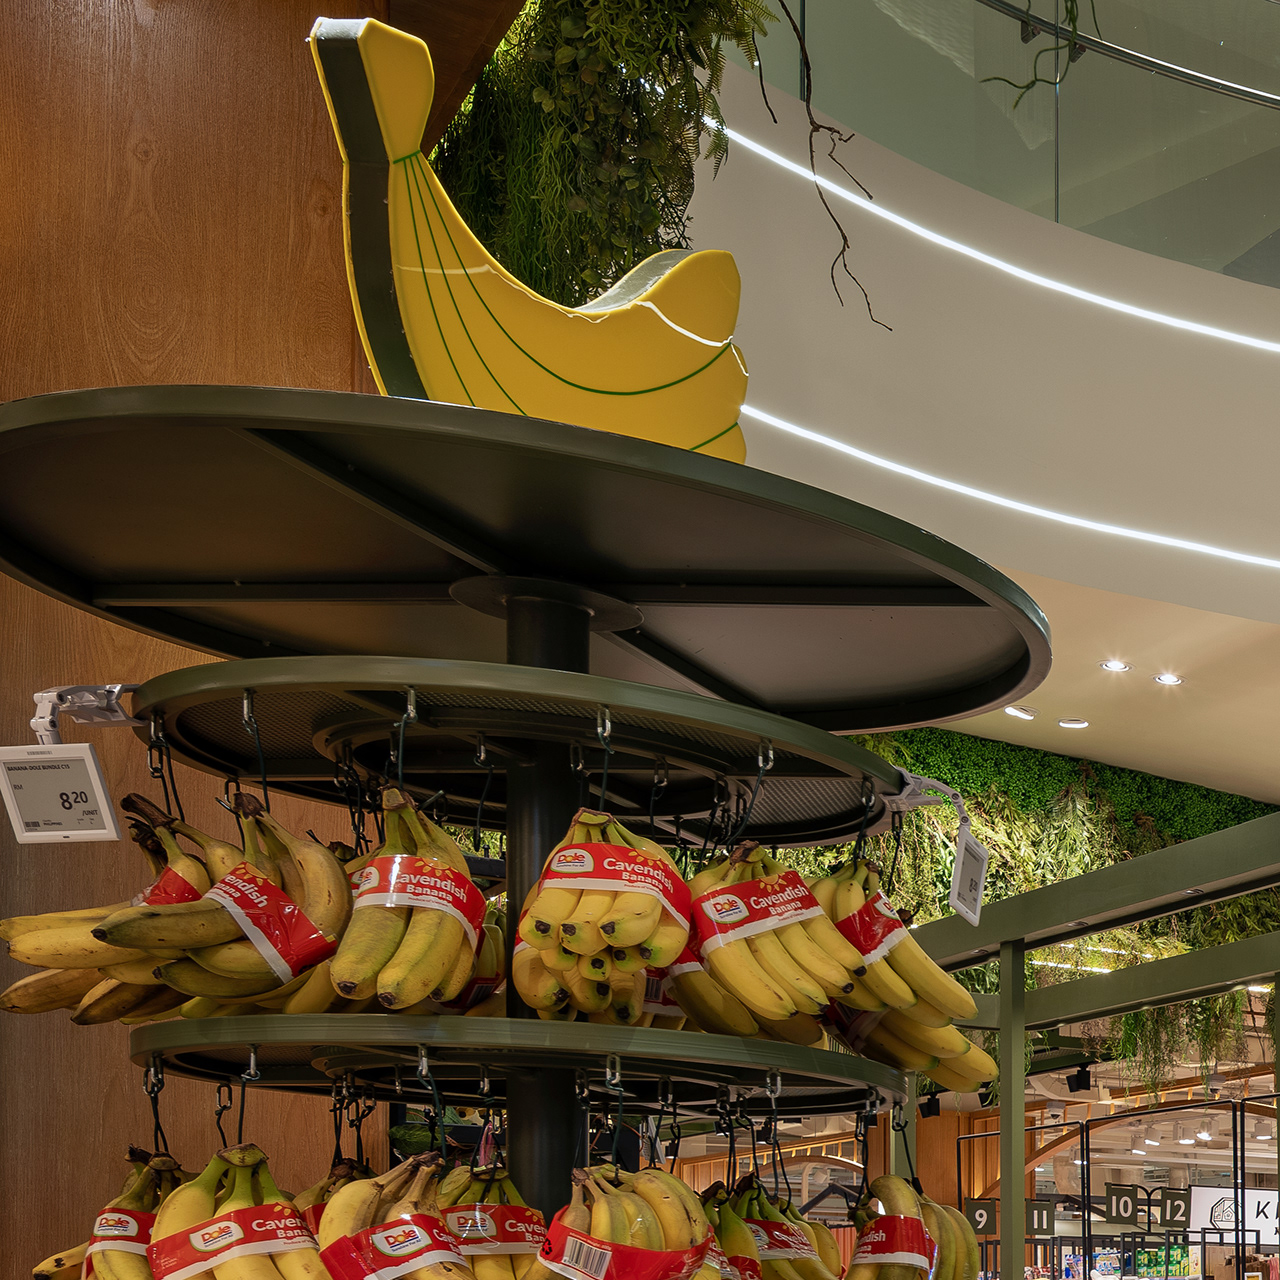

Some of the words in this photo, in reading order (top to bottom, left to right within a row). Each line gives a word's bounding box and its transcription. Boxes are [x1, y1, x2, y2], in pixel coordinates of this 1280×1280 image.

[557, 851, 585, 864] Dole
[603, 857, 674, 895] Cavendish
[621, 871, 664, 891] Banana
[406, 884, 454, 902] Banana
[749, 884, 810, 910] Cavendish
[713, 897, 739, 913] Dole
[769, 900, 803, 916] Banana
[1111, 1195, 1133, 1218] 10
[1165, 1199, 1186, 1221] 12
[100, 1217, 130, 1227] Dole
[252, 1216, 306, 1231] Caven
[504, 1219, 547, 1234] Caven
[974, 1209, 988, 1229] 9
[1033, 1209, 1047, 1229] 11
[201, 1224, 231, 1242] Dole
[276, 1227, 311, 1238] Bana
[384, 1227, 417, 1246] Dole
[525, 1232, 545, 1242] Ban
